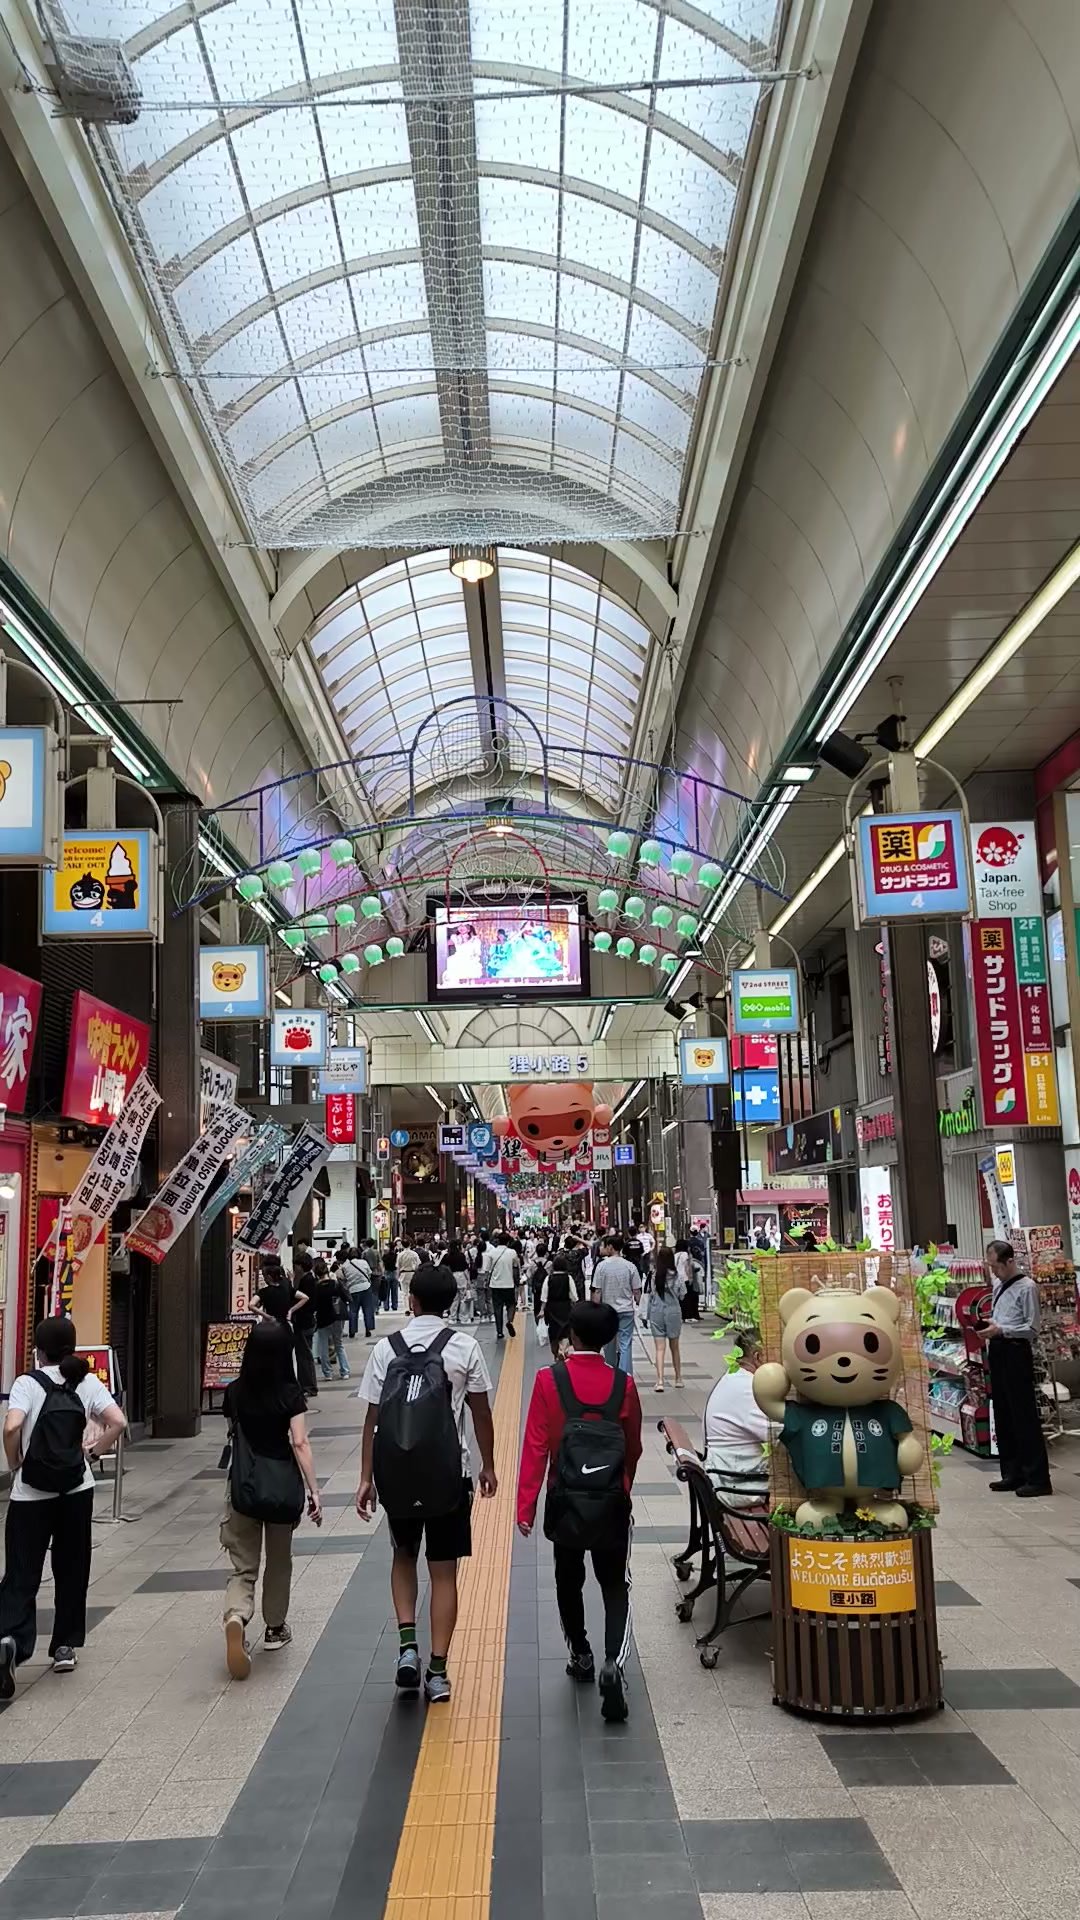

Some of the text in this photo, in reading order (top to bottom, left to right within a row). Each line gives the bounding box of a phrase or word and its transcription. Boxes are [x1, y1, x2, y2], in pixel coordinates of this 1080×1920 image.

[881, 830, 912, 859] 薬
[880, 862, 949, 873] DRUG & COSMETIC
[880, 872, 951, 890] サンドラッグ
[981, 873, 1021, 885] Japan.
[911, 893, 925, 908] 4
[979, 887, 1025, 898] Tax-free
[988, 901, 1017, 911] Shop
[90, 912, 104, 927] 4
[1019, 919, 1037, 930] 2F
[984, 930, 1001, 947] 薬
[1024, 986, 1042, 997] 1F
[224, 1003, 234, 1014] 4
[762, 1019, 772, 1028] 4
[984, 955, 1013, 1084] サンドラッグ
[0, 992, 32, 1090] 家
[329, 1063, 358, 1072] ぶしや
[510, 1055, 588, 1073] 狸小路 5
[1030, 1056, 1049, 1066] B1
[131, 1097, 158, 1146] Sapporo
[211, 1117, 249, 1156] Sapporo
[443, 1136, 462, 1144] Bar
[120, 1148, 138, 1177] Miso
[198, 1155, 221, 1181] Miso
[98, 1179, 126, 1219] Ramen
[177, 1181, 206, 1216] Ramen
[261, 1201, 280, 1223] Broth
[248, 1221, 268, 1246] Ramen
[791, 1548, 913, 1572] ようこそ 熱烈歡迎
[791, 1569, 914, 1587] WELCOME ยินดีต้อนรับ
[832, 1592, 875, 1606] 狸小路
